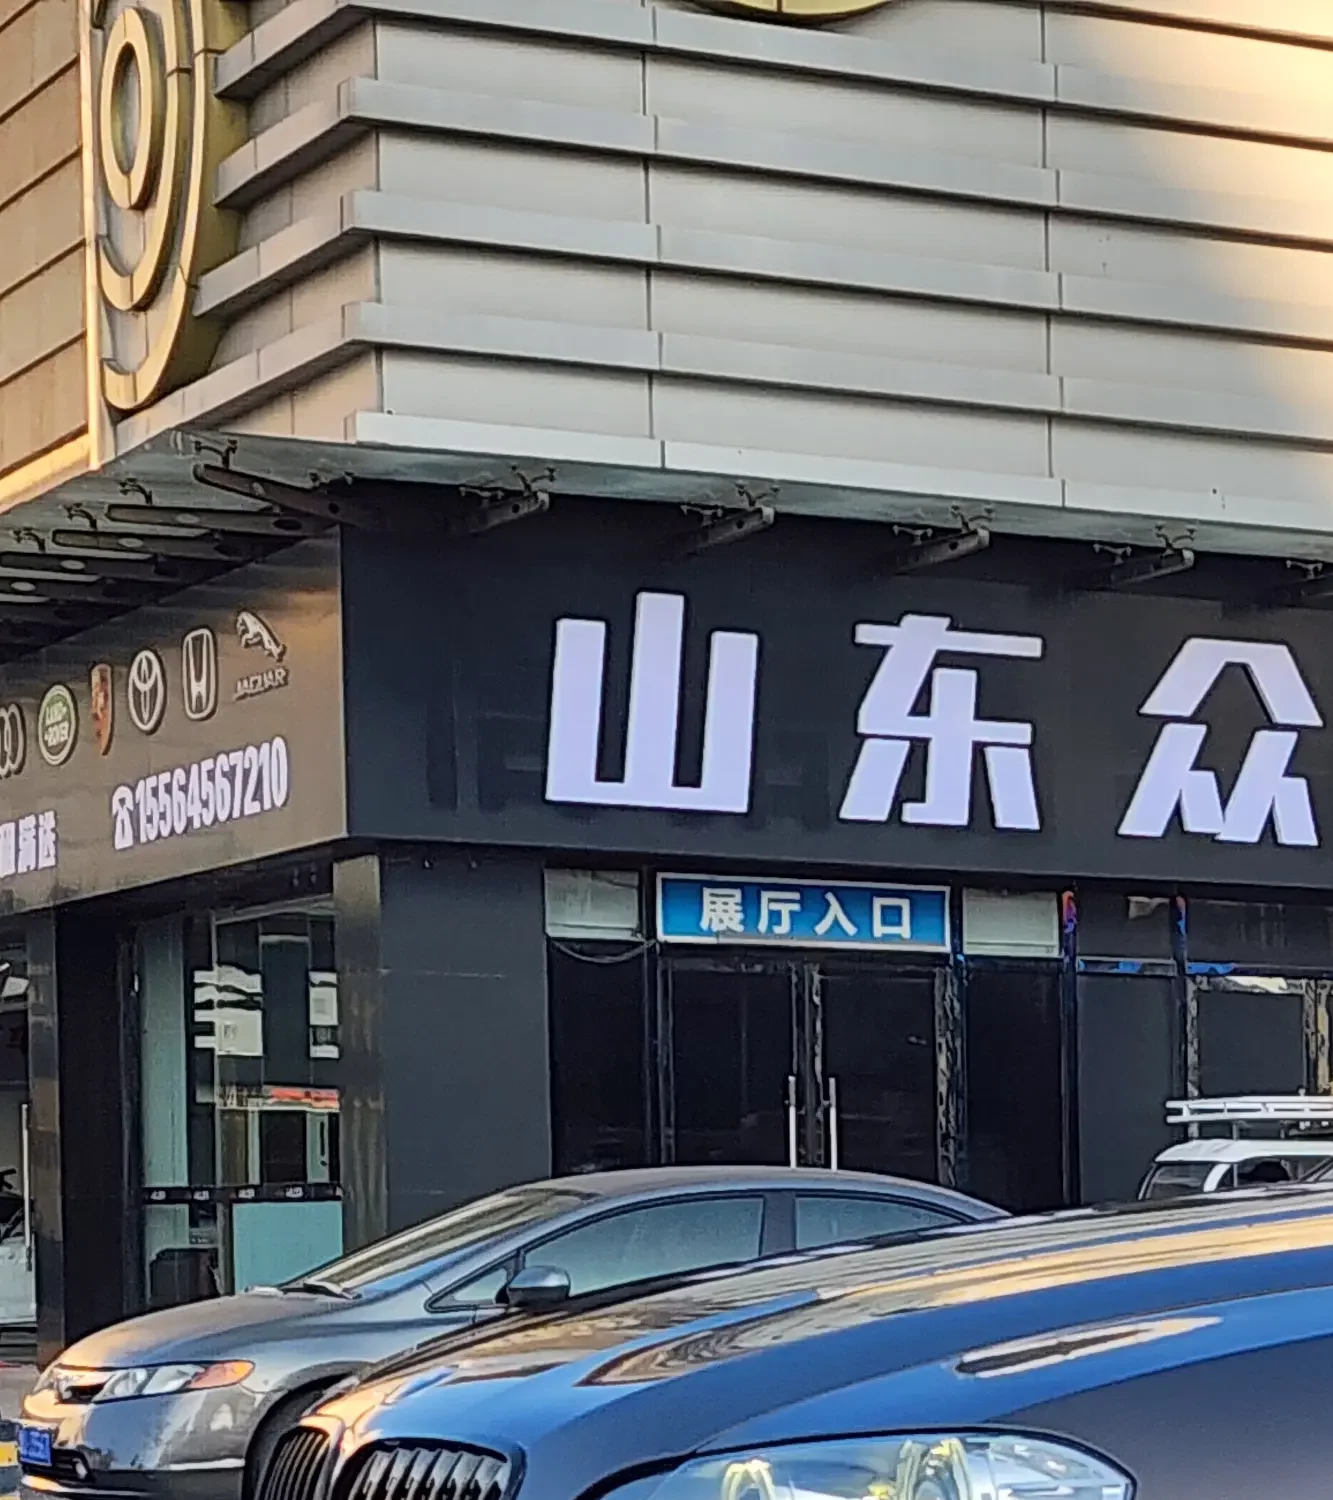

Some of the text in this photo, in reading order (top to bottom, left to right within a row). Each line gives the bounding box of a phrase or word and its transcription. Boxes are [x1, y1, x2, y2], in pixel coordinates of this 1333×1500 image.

[135, 737, 288, 844] 15564567210
[700, 887, 911, 940] 展厅入口
